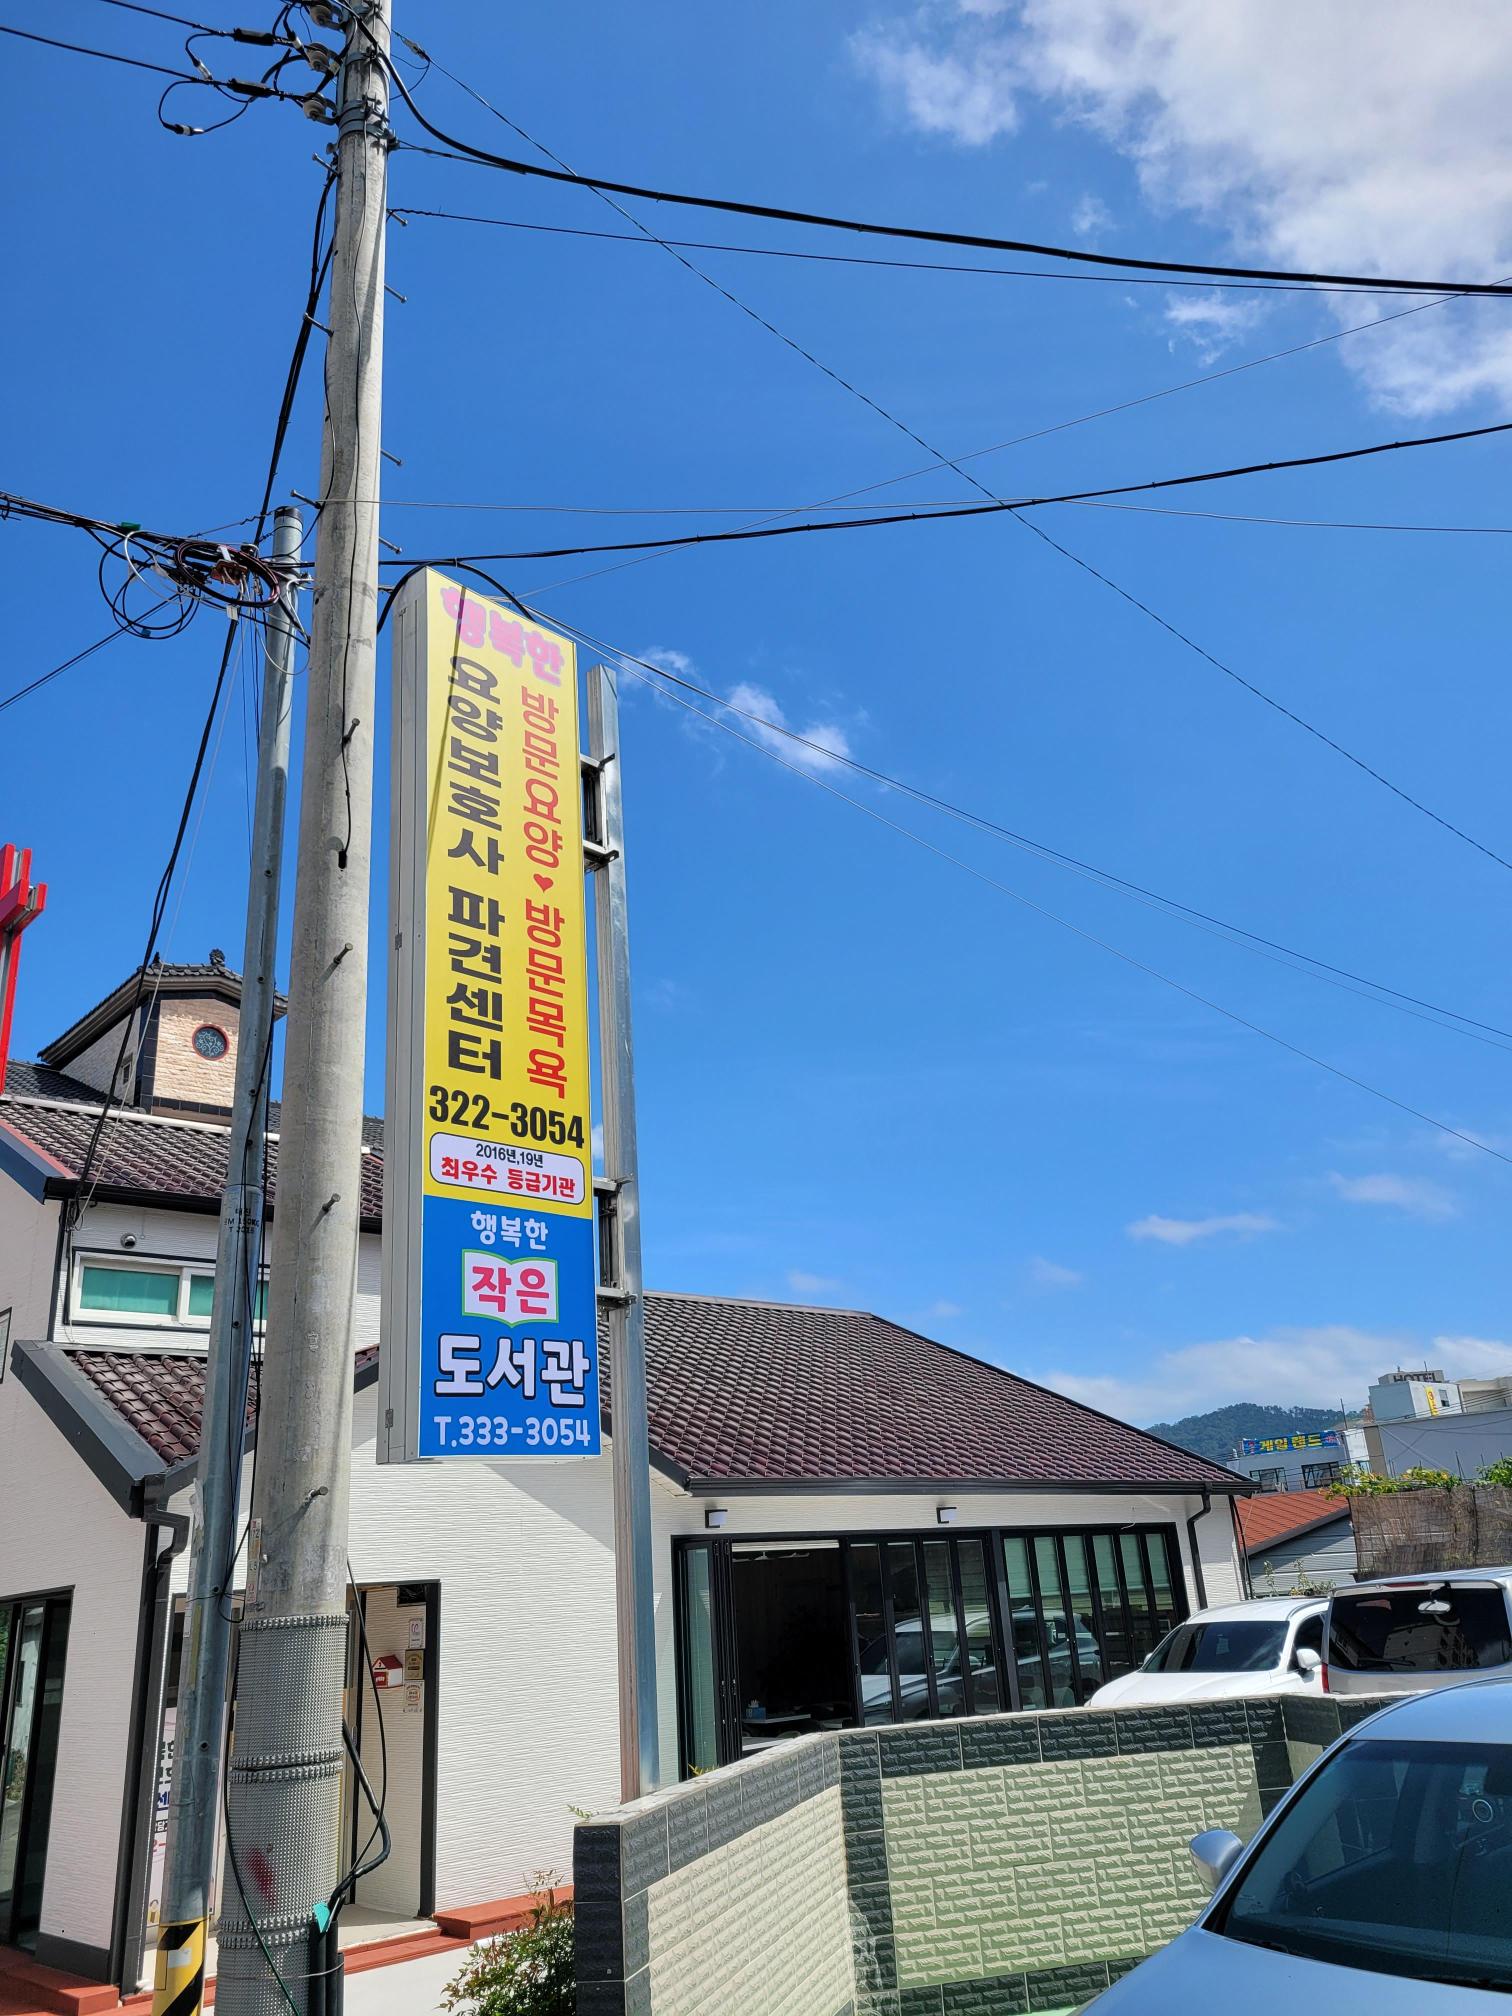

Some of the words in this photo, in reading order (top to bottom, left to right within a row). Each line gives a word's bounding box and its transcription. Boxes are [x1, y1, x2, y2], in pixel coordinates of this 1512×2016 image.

[440, 587, 564, 687] 행복한
[447, 655, 505, 876] 요양보호사
[520, 685, 564, 869] 방문요양
[446, 885, 505, 1080] 파견센터
[525, 898, 568, 1099] 방문목욕
[429, 1085, 585, 1148] 322-3054
[441, 1156, 498, 1185] 최우수
[507, 1168, 576, 1198] 등급기관
[470, 1210, 548, 1250] 행복한
[472, 1266, 549, 1314] 작은
[435, 1334, 590, 1405] 도서관
[434, 1416, 590, 1447] T.333-3054
